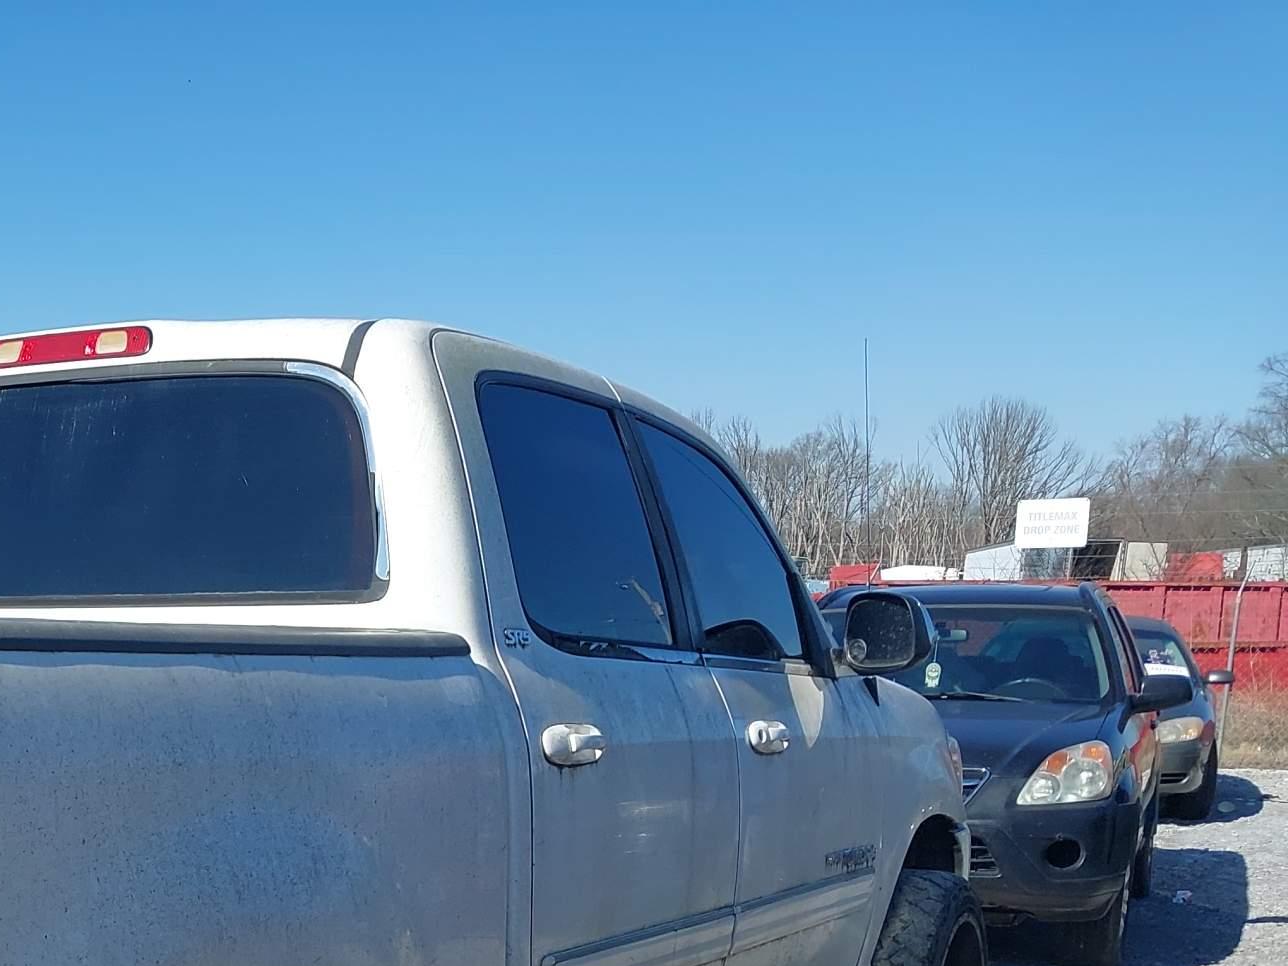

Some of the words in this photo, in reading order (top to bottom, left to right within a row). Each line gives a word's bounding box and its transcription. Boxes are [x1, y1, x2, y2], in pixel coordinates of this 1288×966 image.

[1028, 511, 1079, 521] TITLEMAX
[1023, 525, 1051, 536] DROP
[1053, 524, 1081, 535] ZONE
